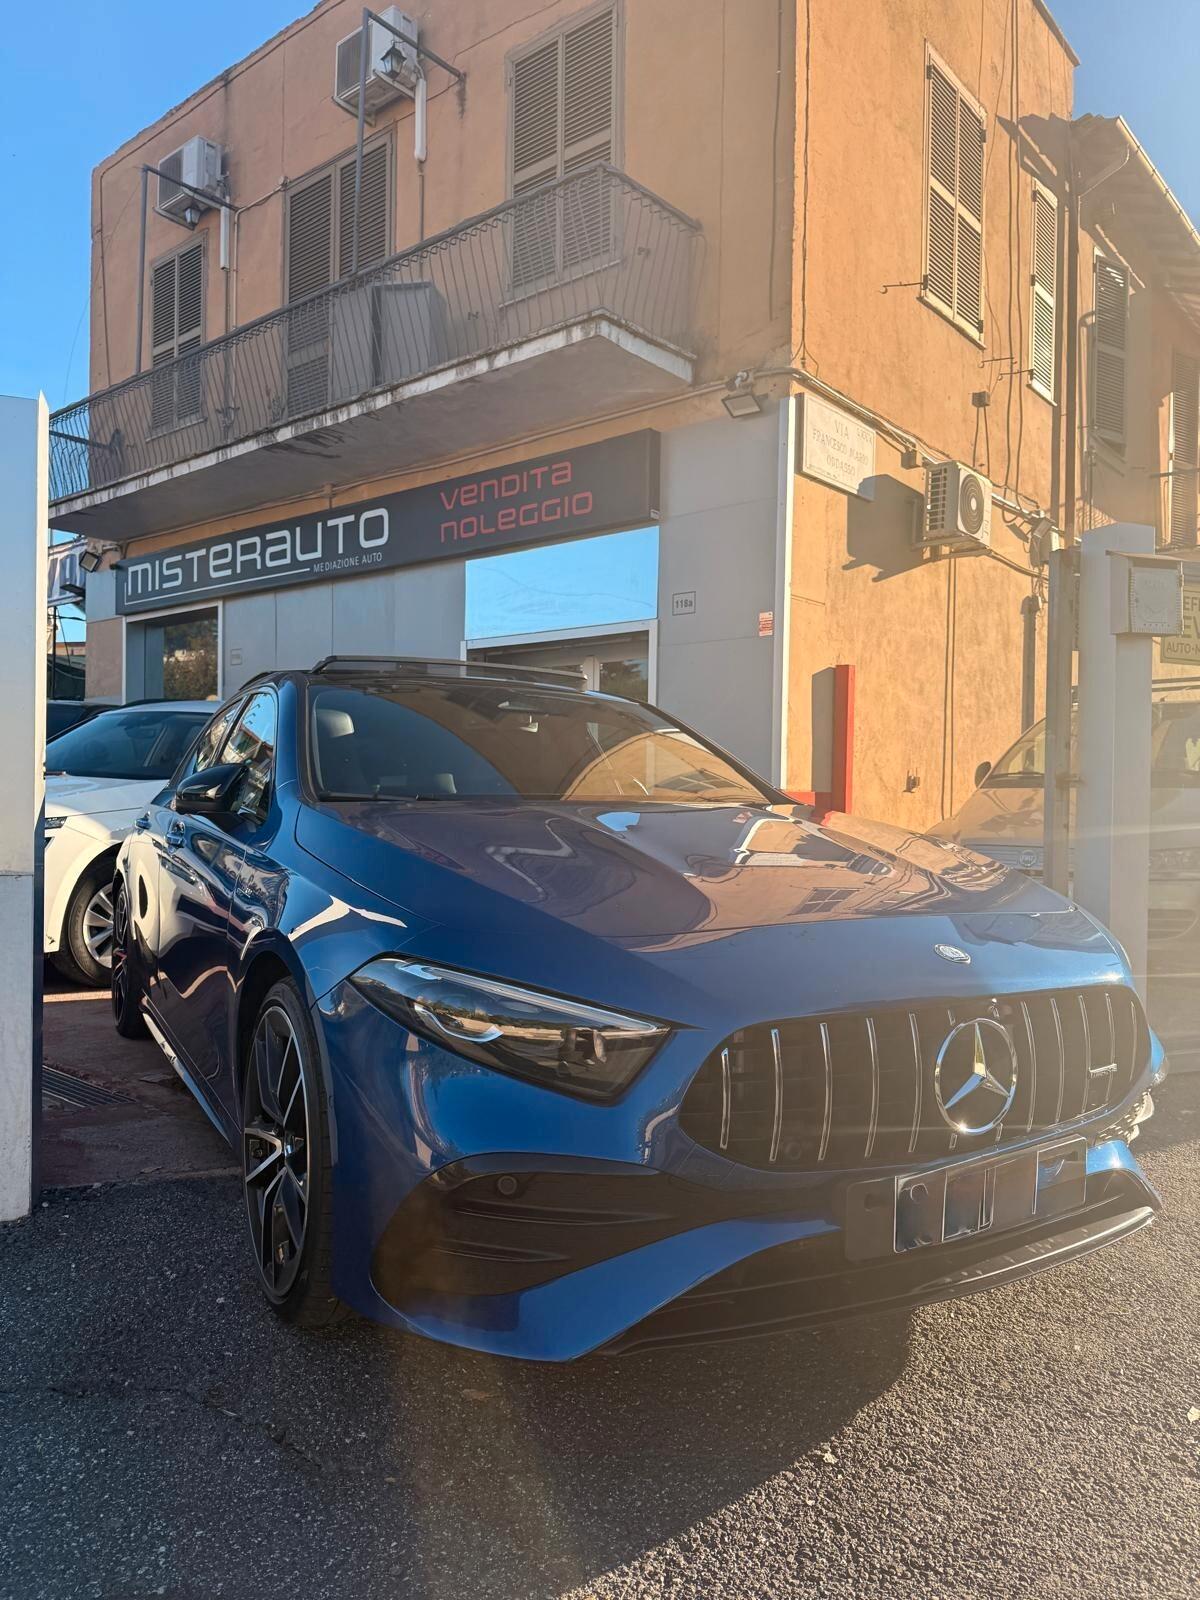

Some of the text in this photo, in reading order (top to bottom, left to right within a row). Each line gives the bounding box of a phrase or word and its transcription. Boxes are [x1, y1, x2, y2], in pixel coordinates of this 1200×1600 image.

[834, 419, 850, 440] VIA
[313, 551, 383, 573] MEDIAZIONE AUTO
